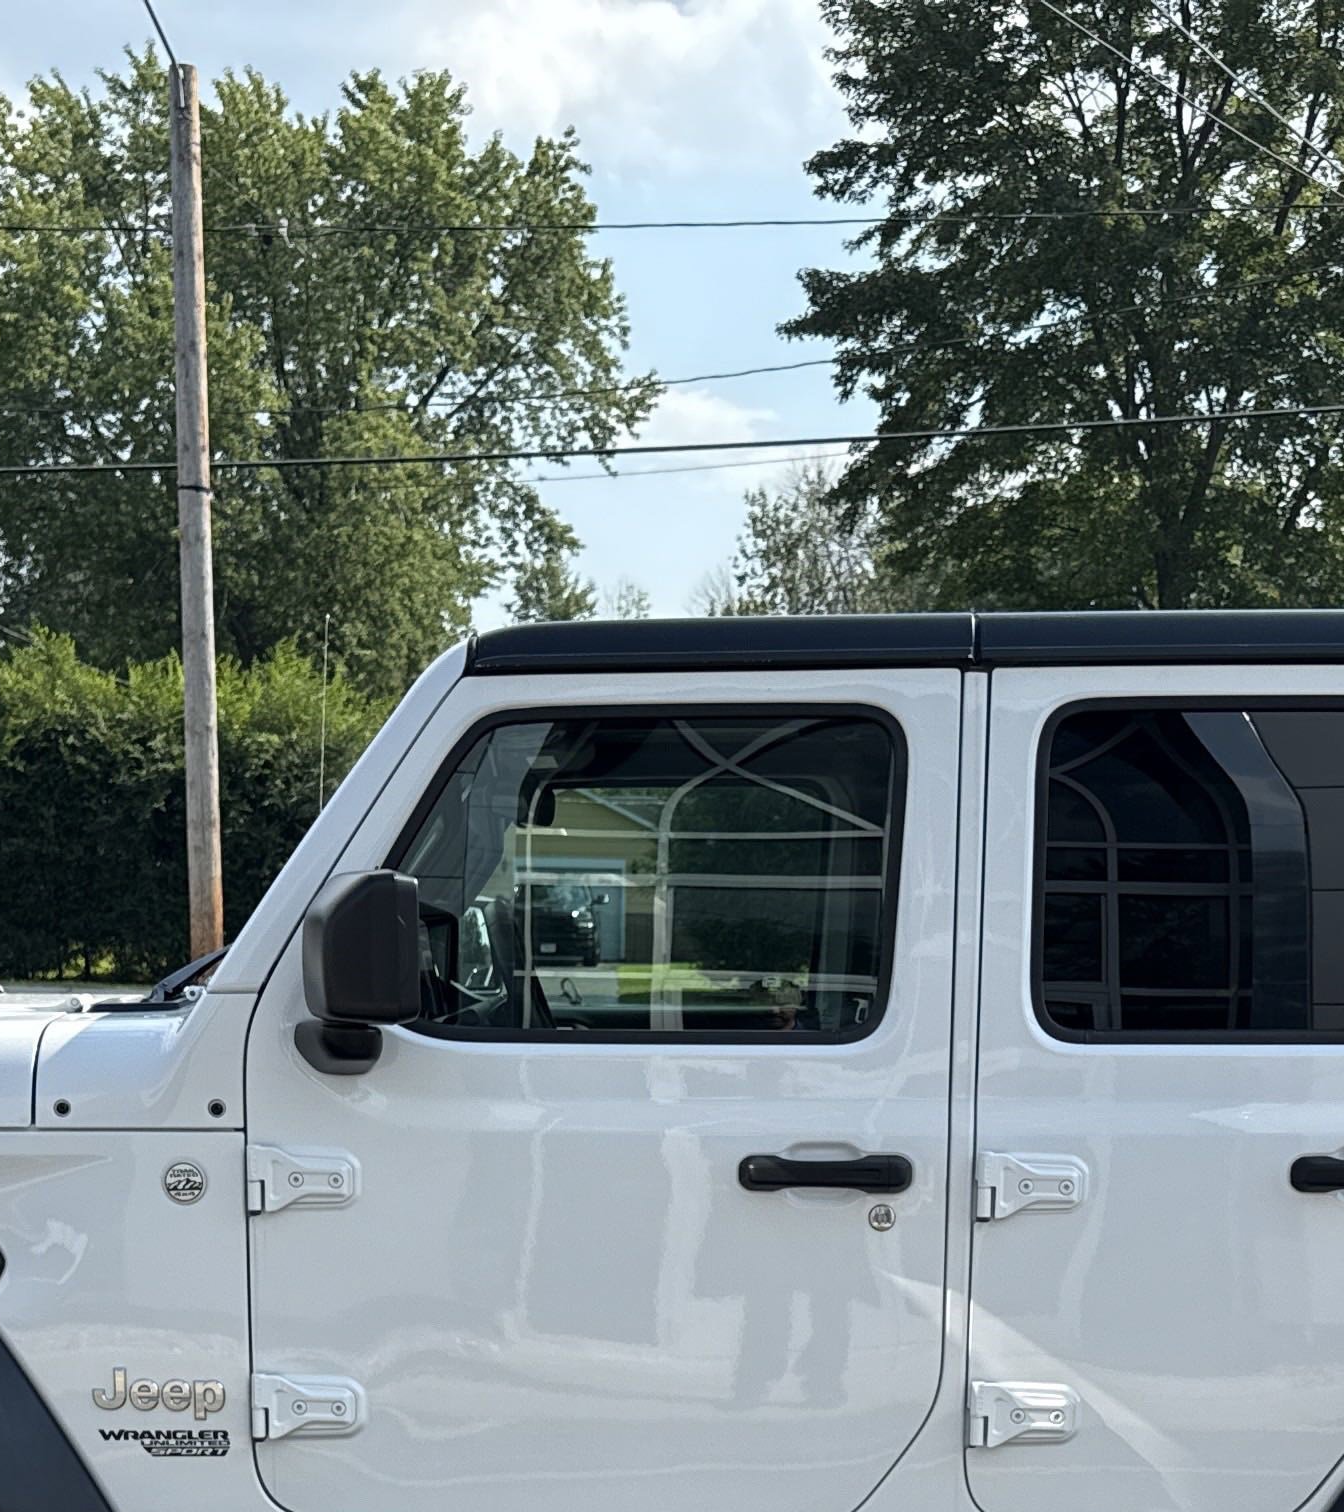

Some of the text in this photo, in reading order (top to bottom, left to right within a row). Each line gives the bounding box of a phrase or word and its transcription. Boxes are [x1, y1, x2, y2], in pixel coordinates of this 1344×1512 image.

[91, 1366, 226, 1421] Jeep
[98, 1429, 230, 1441] WRANGLER
[150, 1448, 227, 1456] SPORT
